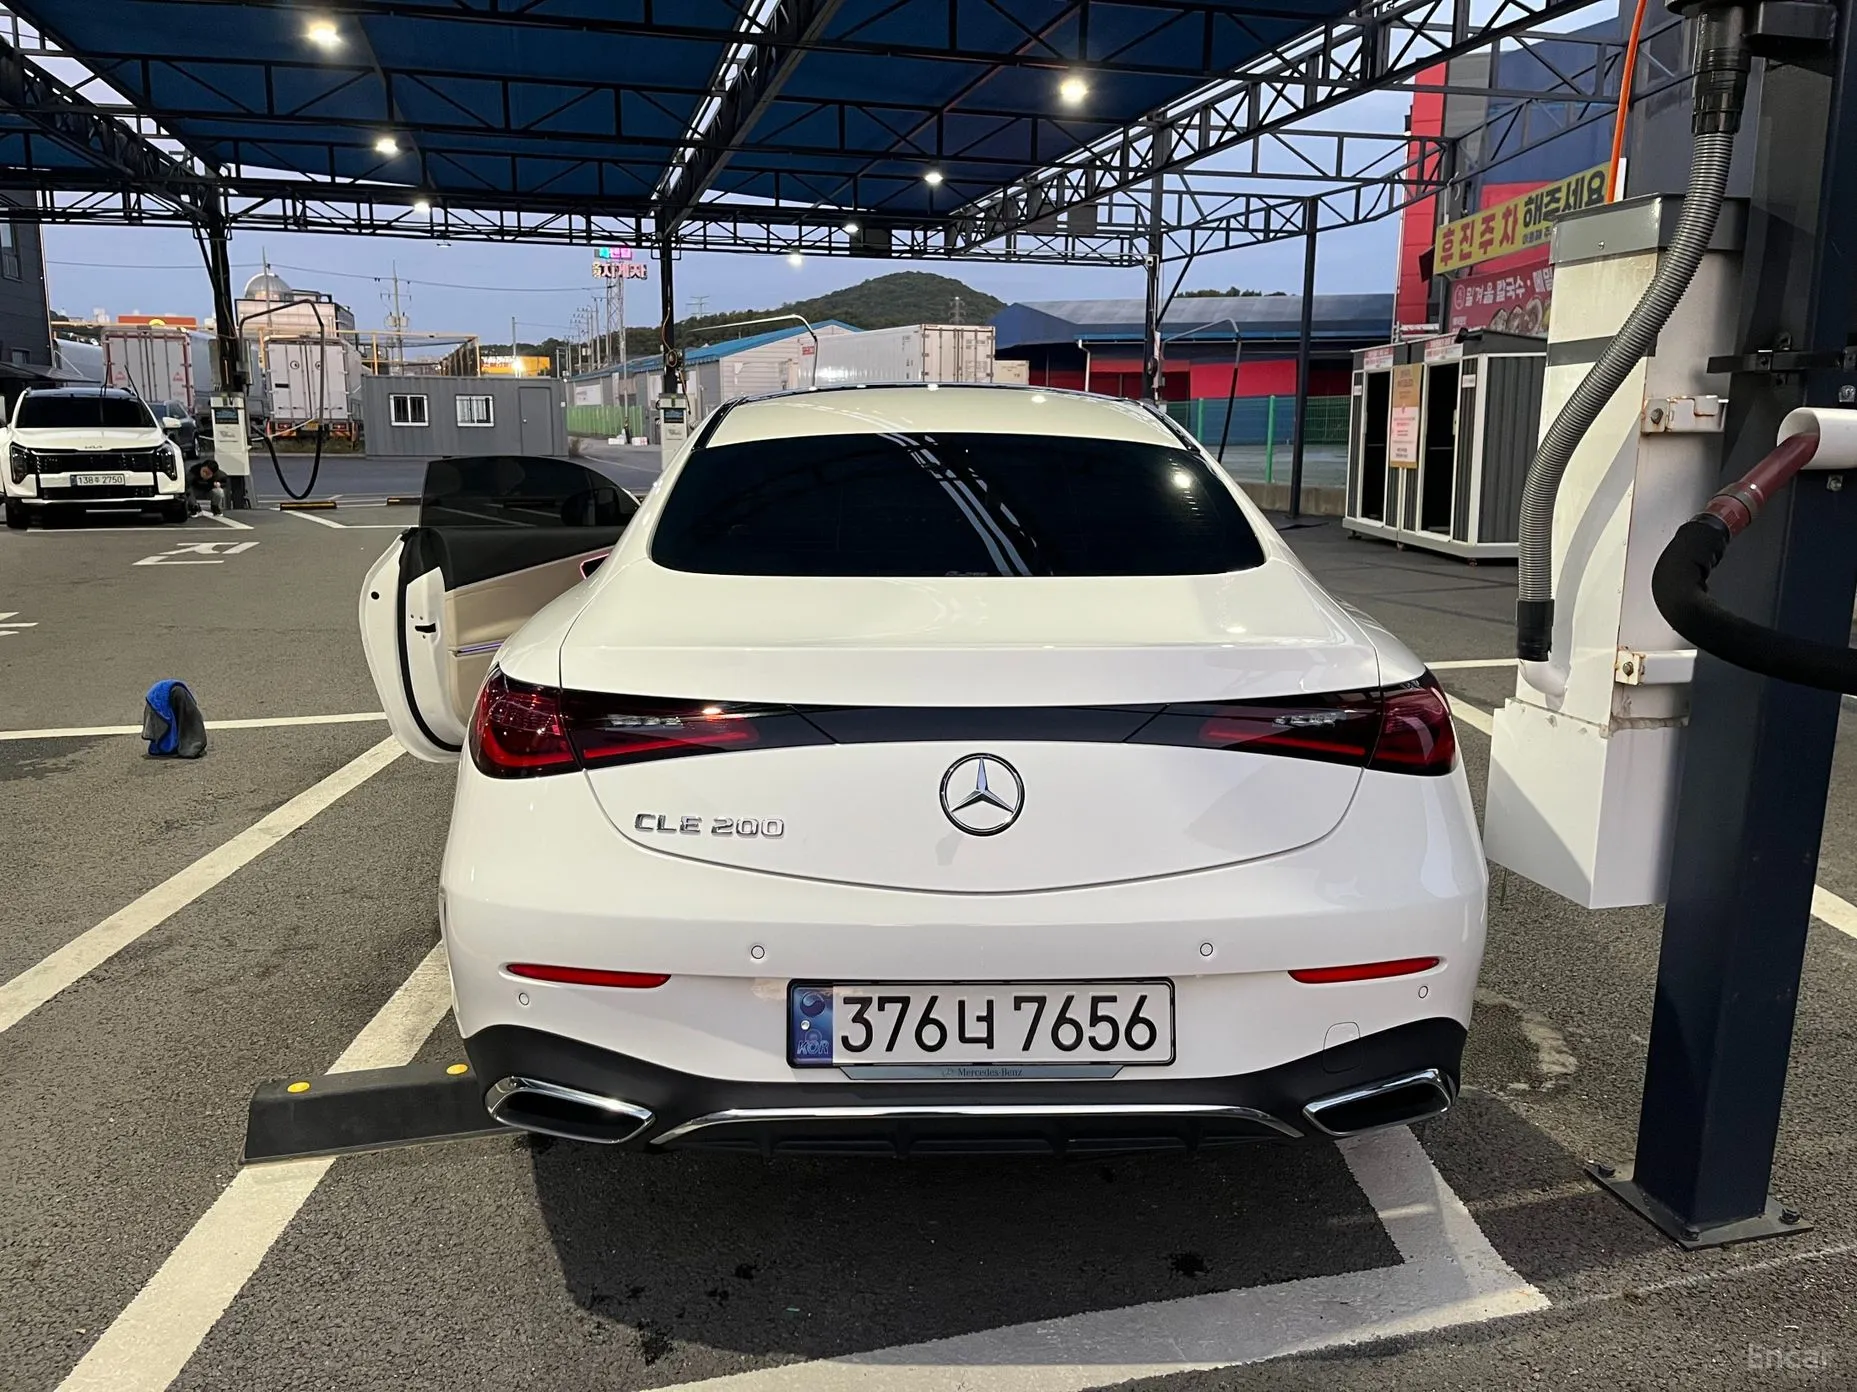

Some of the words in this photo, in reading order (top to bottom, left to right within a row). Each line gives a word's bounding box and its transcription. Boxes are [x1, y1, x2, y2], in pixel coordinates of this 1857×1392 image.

[1440, 203, 1519, 266] 후진주차
[1523, 170, 1606, 228] 해주세요
[1496, 275, 1526, 303] 칼국수
[102, 475, 123, 484] 2750
[635, 813, 701, 834] CLE
[711, 816, 785, 839] 200
[840, 995, 995, 1053] 376너
[1013, 994, 1157, 1052] 7656
[797, 1039, 830, 1055] KOR
[957, 1067, 1023, 1078] Mercedes-Benz
